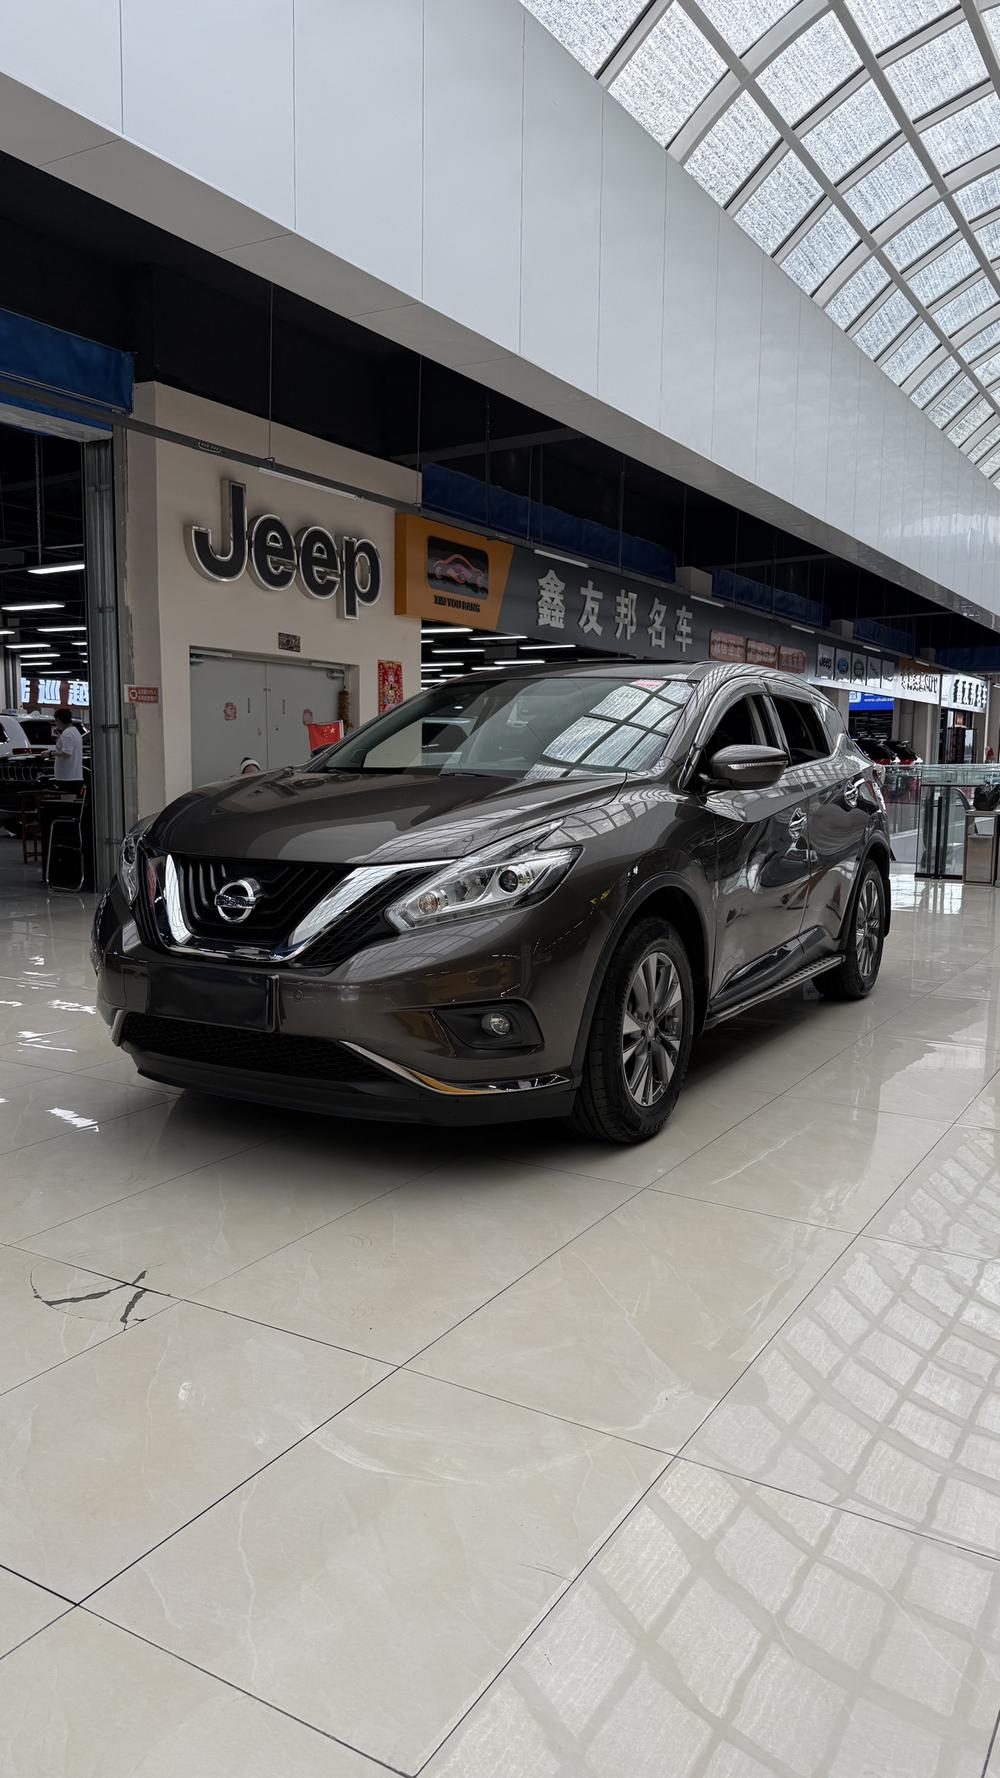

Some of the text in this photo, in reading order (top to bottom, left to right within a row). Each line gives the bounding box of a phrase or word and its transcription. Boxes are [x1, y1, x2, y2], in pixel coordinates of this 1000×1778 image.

[186, 479, 382, 621] Jeep
[447, 597, 461, 609] YOU
[537, 568, 693, 653] 鑫友邦名车
[819, 655, 832, 670] Jeep
